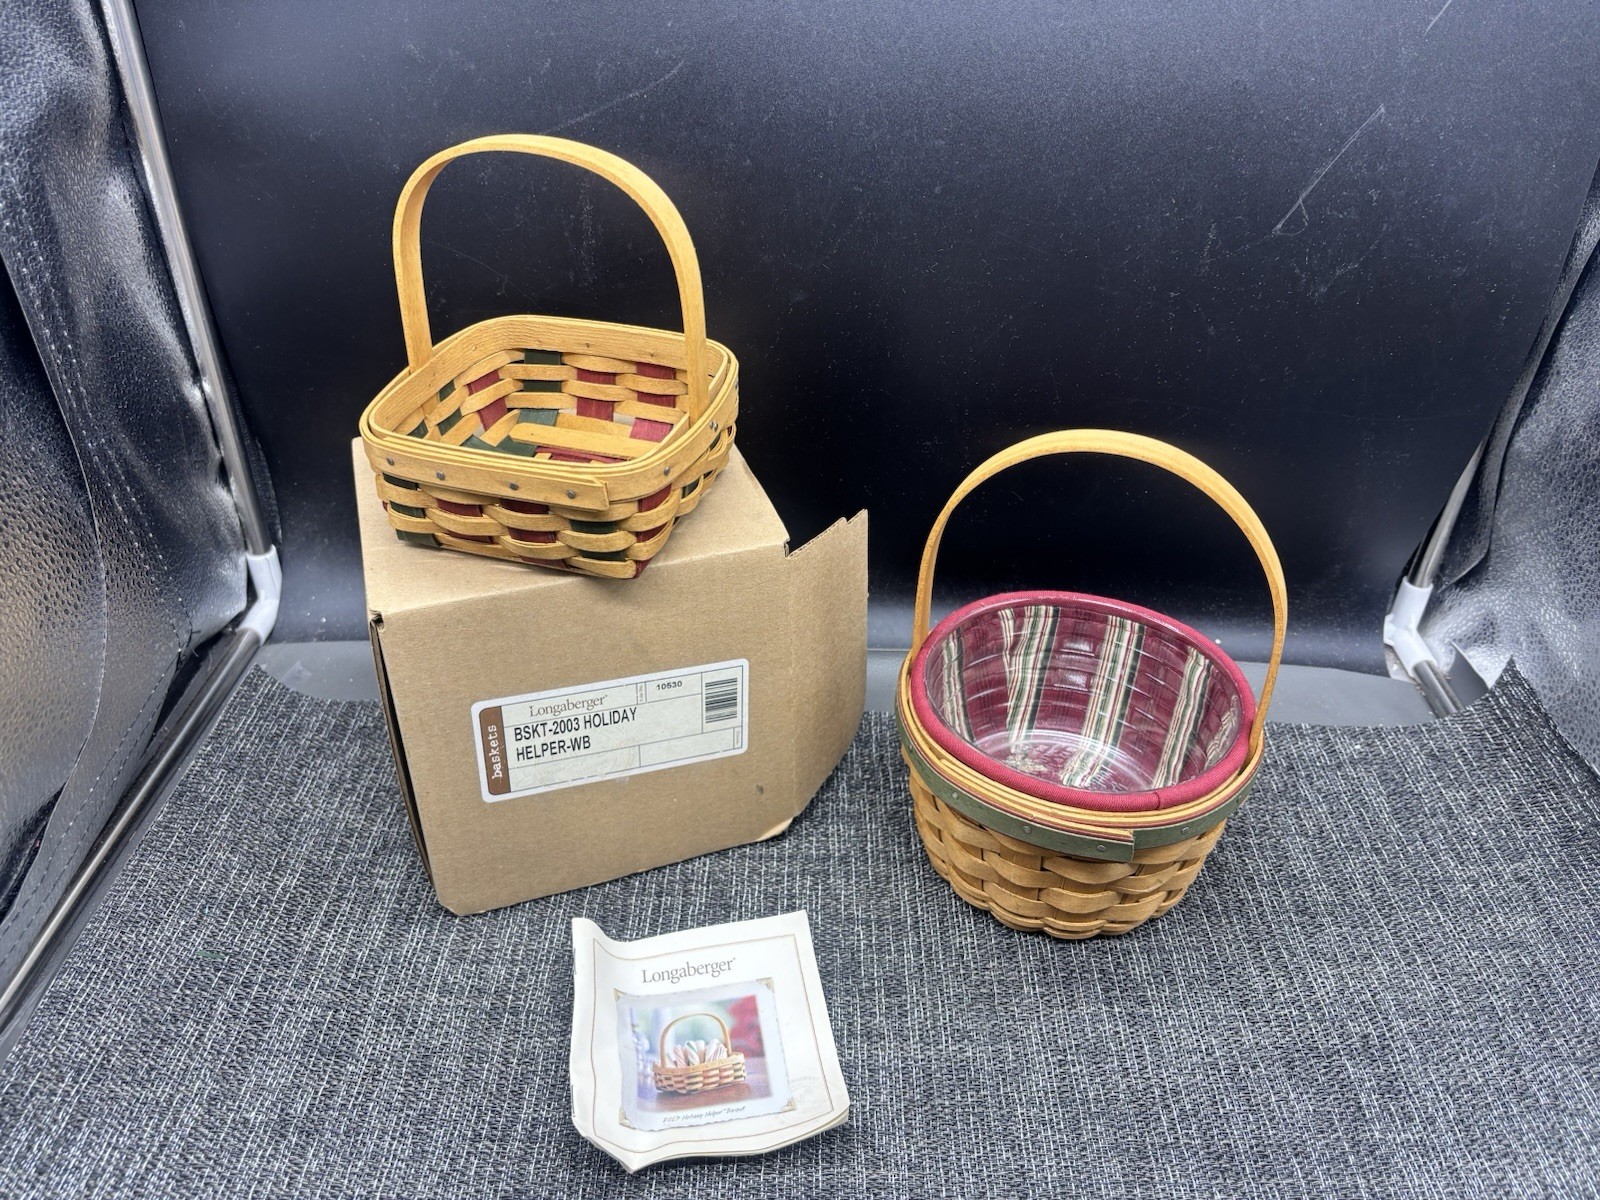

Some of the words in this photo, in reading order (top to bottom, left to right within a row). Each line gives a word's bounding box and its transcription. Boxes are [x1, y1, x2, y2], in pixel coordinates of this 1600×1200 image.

[529, 696, 606, 718] Longaberger
[514, 717, 581, 742] BSKT-2003
[584, 707, 638, 730] HOLIDAY
[488, 724, 503, 780] baskets
[516, 735, 591, 762] HELPER-WB
[641, 960, 734, 985] Longaberger
